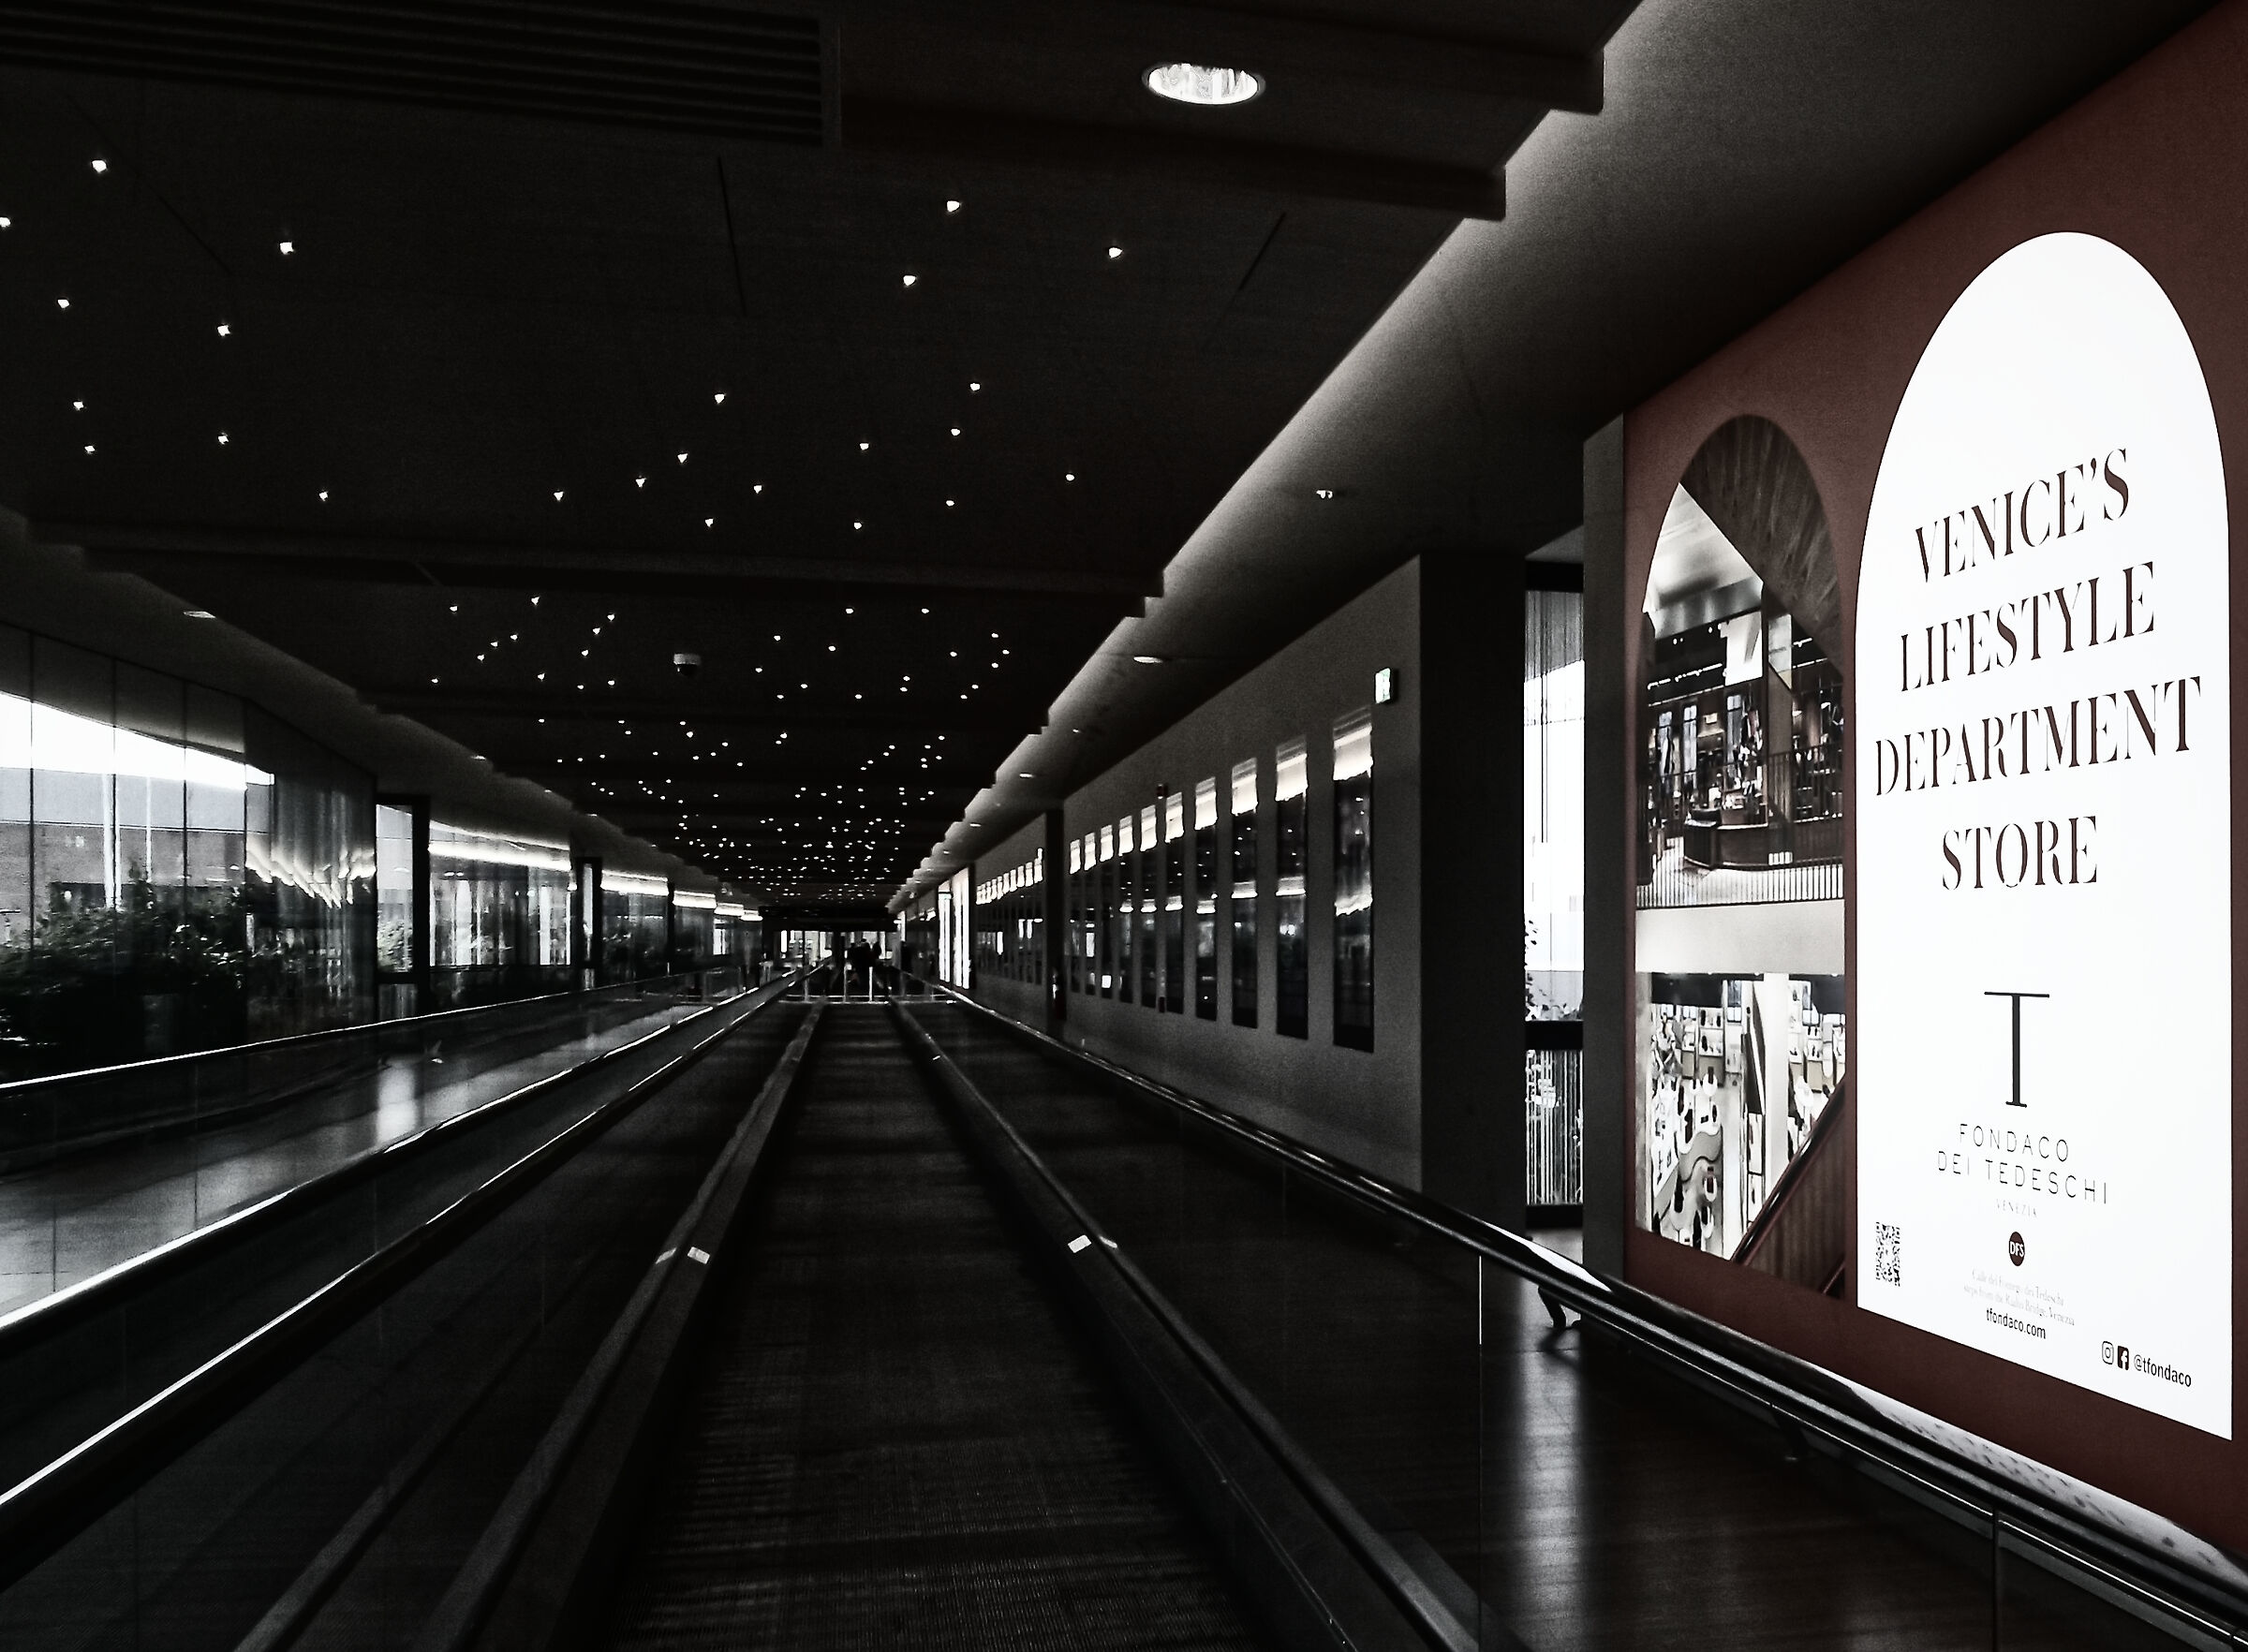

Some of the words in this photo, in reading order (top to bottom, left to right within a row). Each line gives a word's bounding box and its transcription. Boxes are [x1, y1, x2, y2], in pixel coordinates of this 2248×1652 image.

[1915, 448, 2130, 583] VENICE'S
[1900, 560, 2154, 692] LIFESTYLE
[1876, 675, 2201, 796] DEPARTMENT
[1942, 815, 2098, 891] STORE
[1984, 991, 2050, 1108] T
[1960, 1123, 2069, 1162] FONDACO
[1937, 1150, 1971, 1175] DEI
[1985, 1158, 2107, 1205] TEDESCHI
[1996, 1198, 2037, 1218] VENEZIA
[2009, 1240, 2025, 1258] DFS
[1986, 1307, 2047, 1340] tfondaco.com
[2134, 1354, 2192, 1387] @tfondaco
